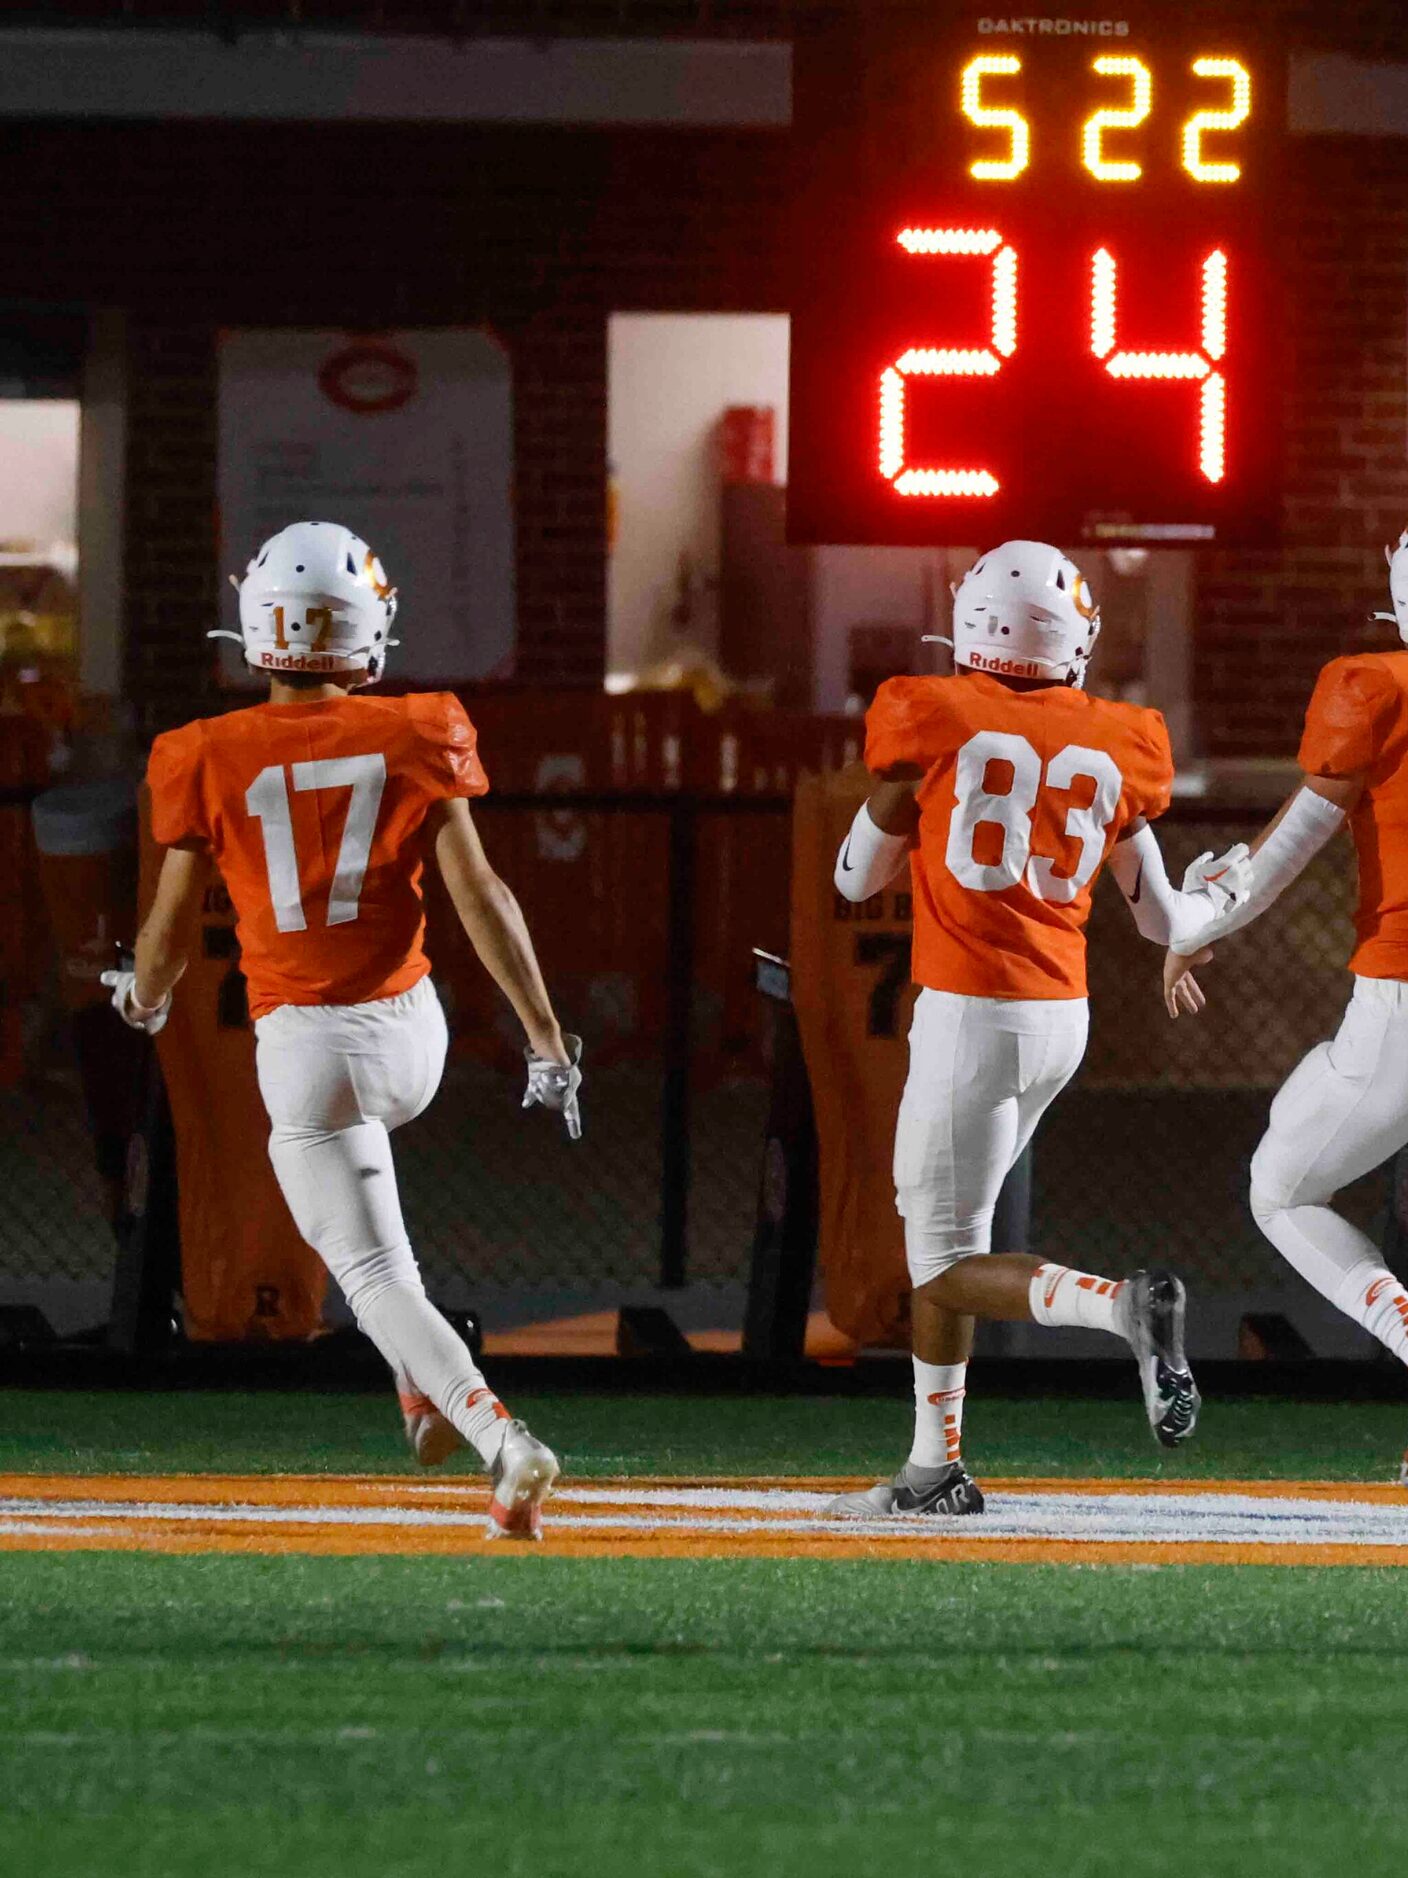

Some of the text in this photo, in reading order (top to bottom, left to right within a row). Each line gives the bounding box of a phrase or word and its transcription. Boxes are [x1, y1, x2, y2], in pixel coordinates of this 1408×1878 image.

[977, 17, 1130, 37] DAKTRONICS
[878, 227, 1227, 497] 24
[260, 652, 335, 669] Riddell
[969, 652, 1039, 677] Riddell
[246, 753, 386, 932] 17
[944, 731, 1122, 902] 83
